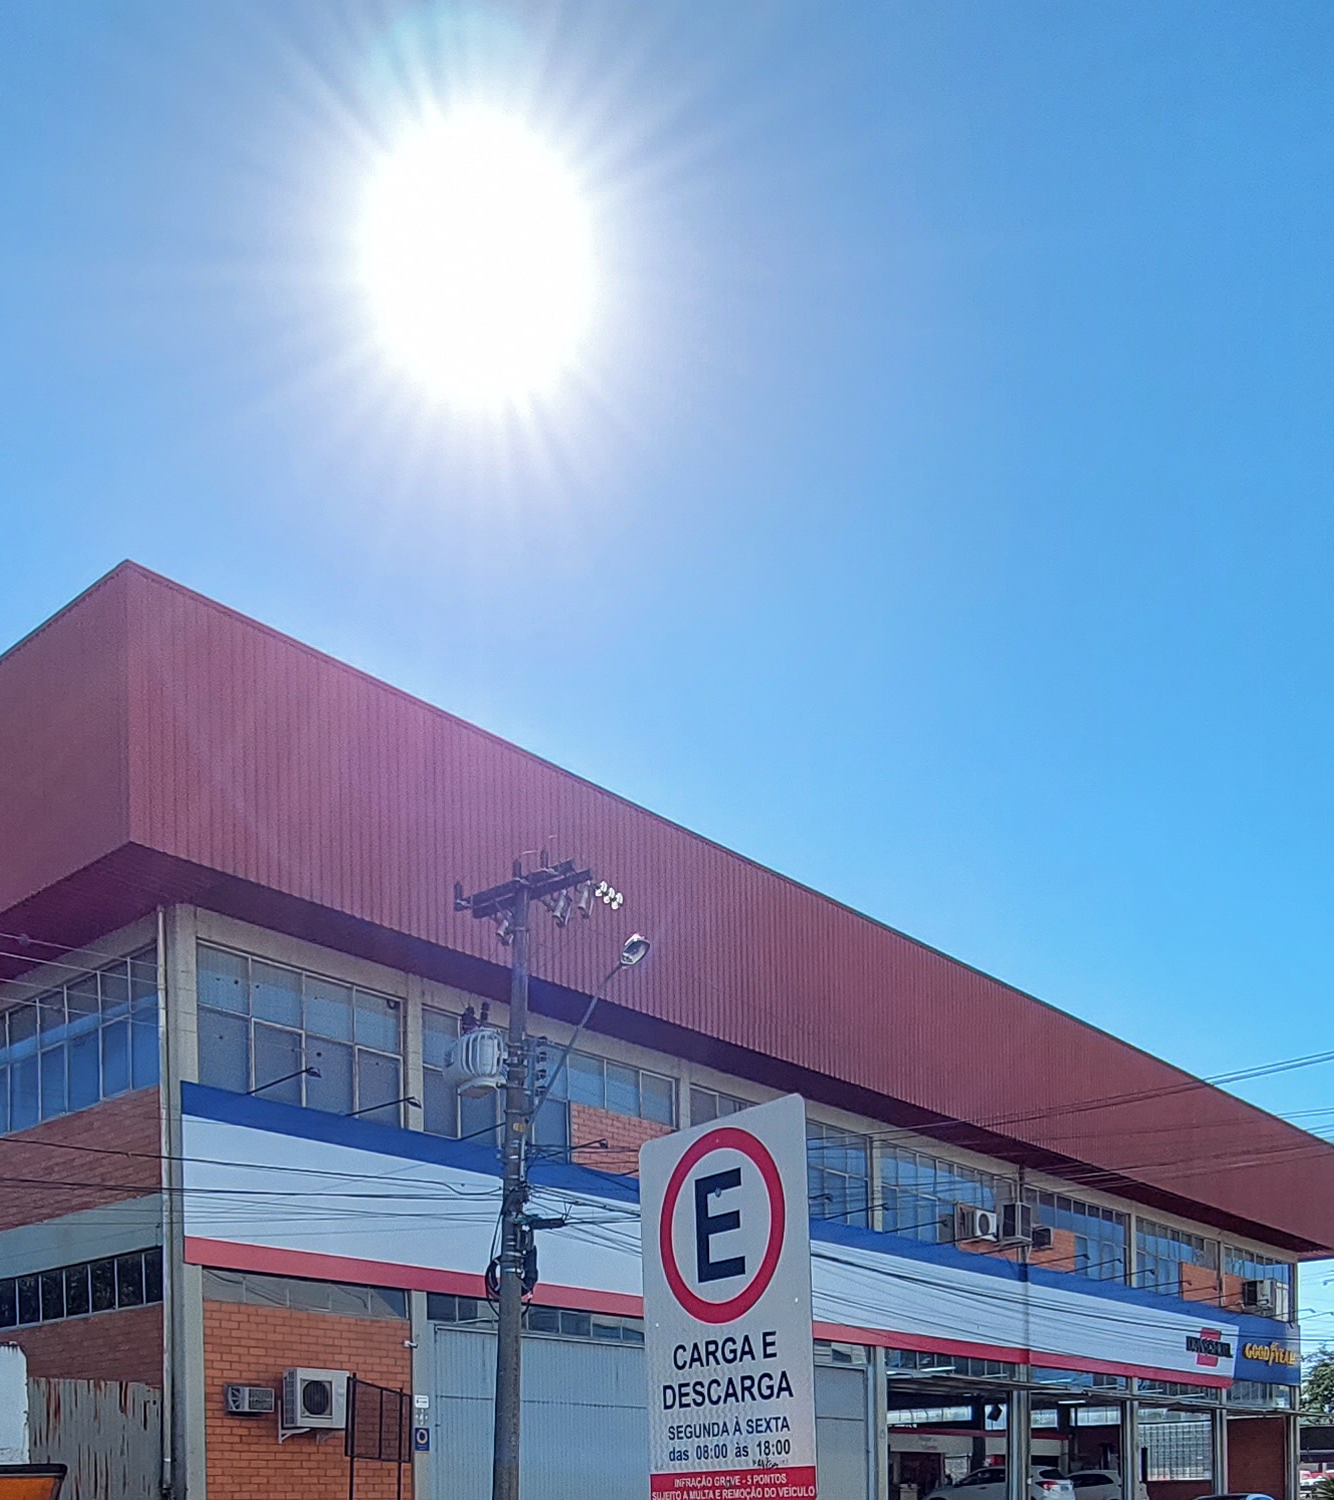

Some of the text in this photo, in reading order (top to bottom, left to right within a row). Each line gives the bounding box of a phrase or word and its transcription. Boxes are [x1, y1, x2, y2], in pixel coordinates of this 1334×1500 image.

[695, 1167, 746, 1284] E
[673, 1330, 777, 1371] CARGA E
[662, 1370, 794, 1410] DESCARGA
[668, 1415, 791, 1441] SEGUNDA À SEXTA
[668, 1439, 791, 1462] das 08:00 às 18:00
[651, 1490, 682, 1500] SUJEITO
[689, 1489, 714, 1500] MULTA
[722, 1486, 763, 1500] REMOÇÃO
[764, 1487, 777, 1498] DO
[777, 1484, 815, 1498] VEÍCULO
[674, 1475, 713, 1489] INFRAÇÃO
[753, 1473, 787, 1485] PONTOS
